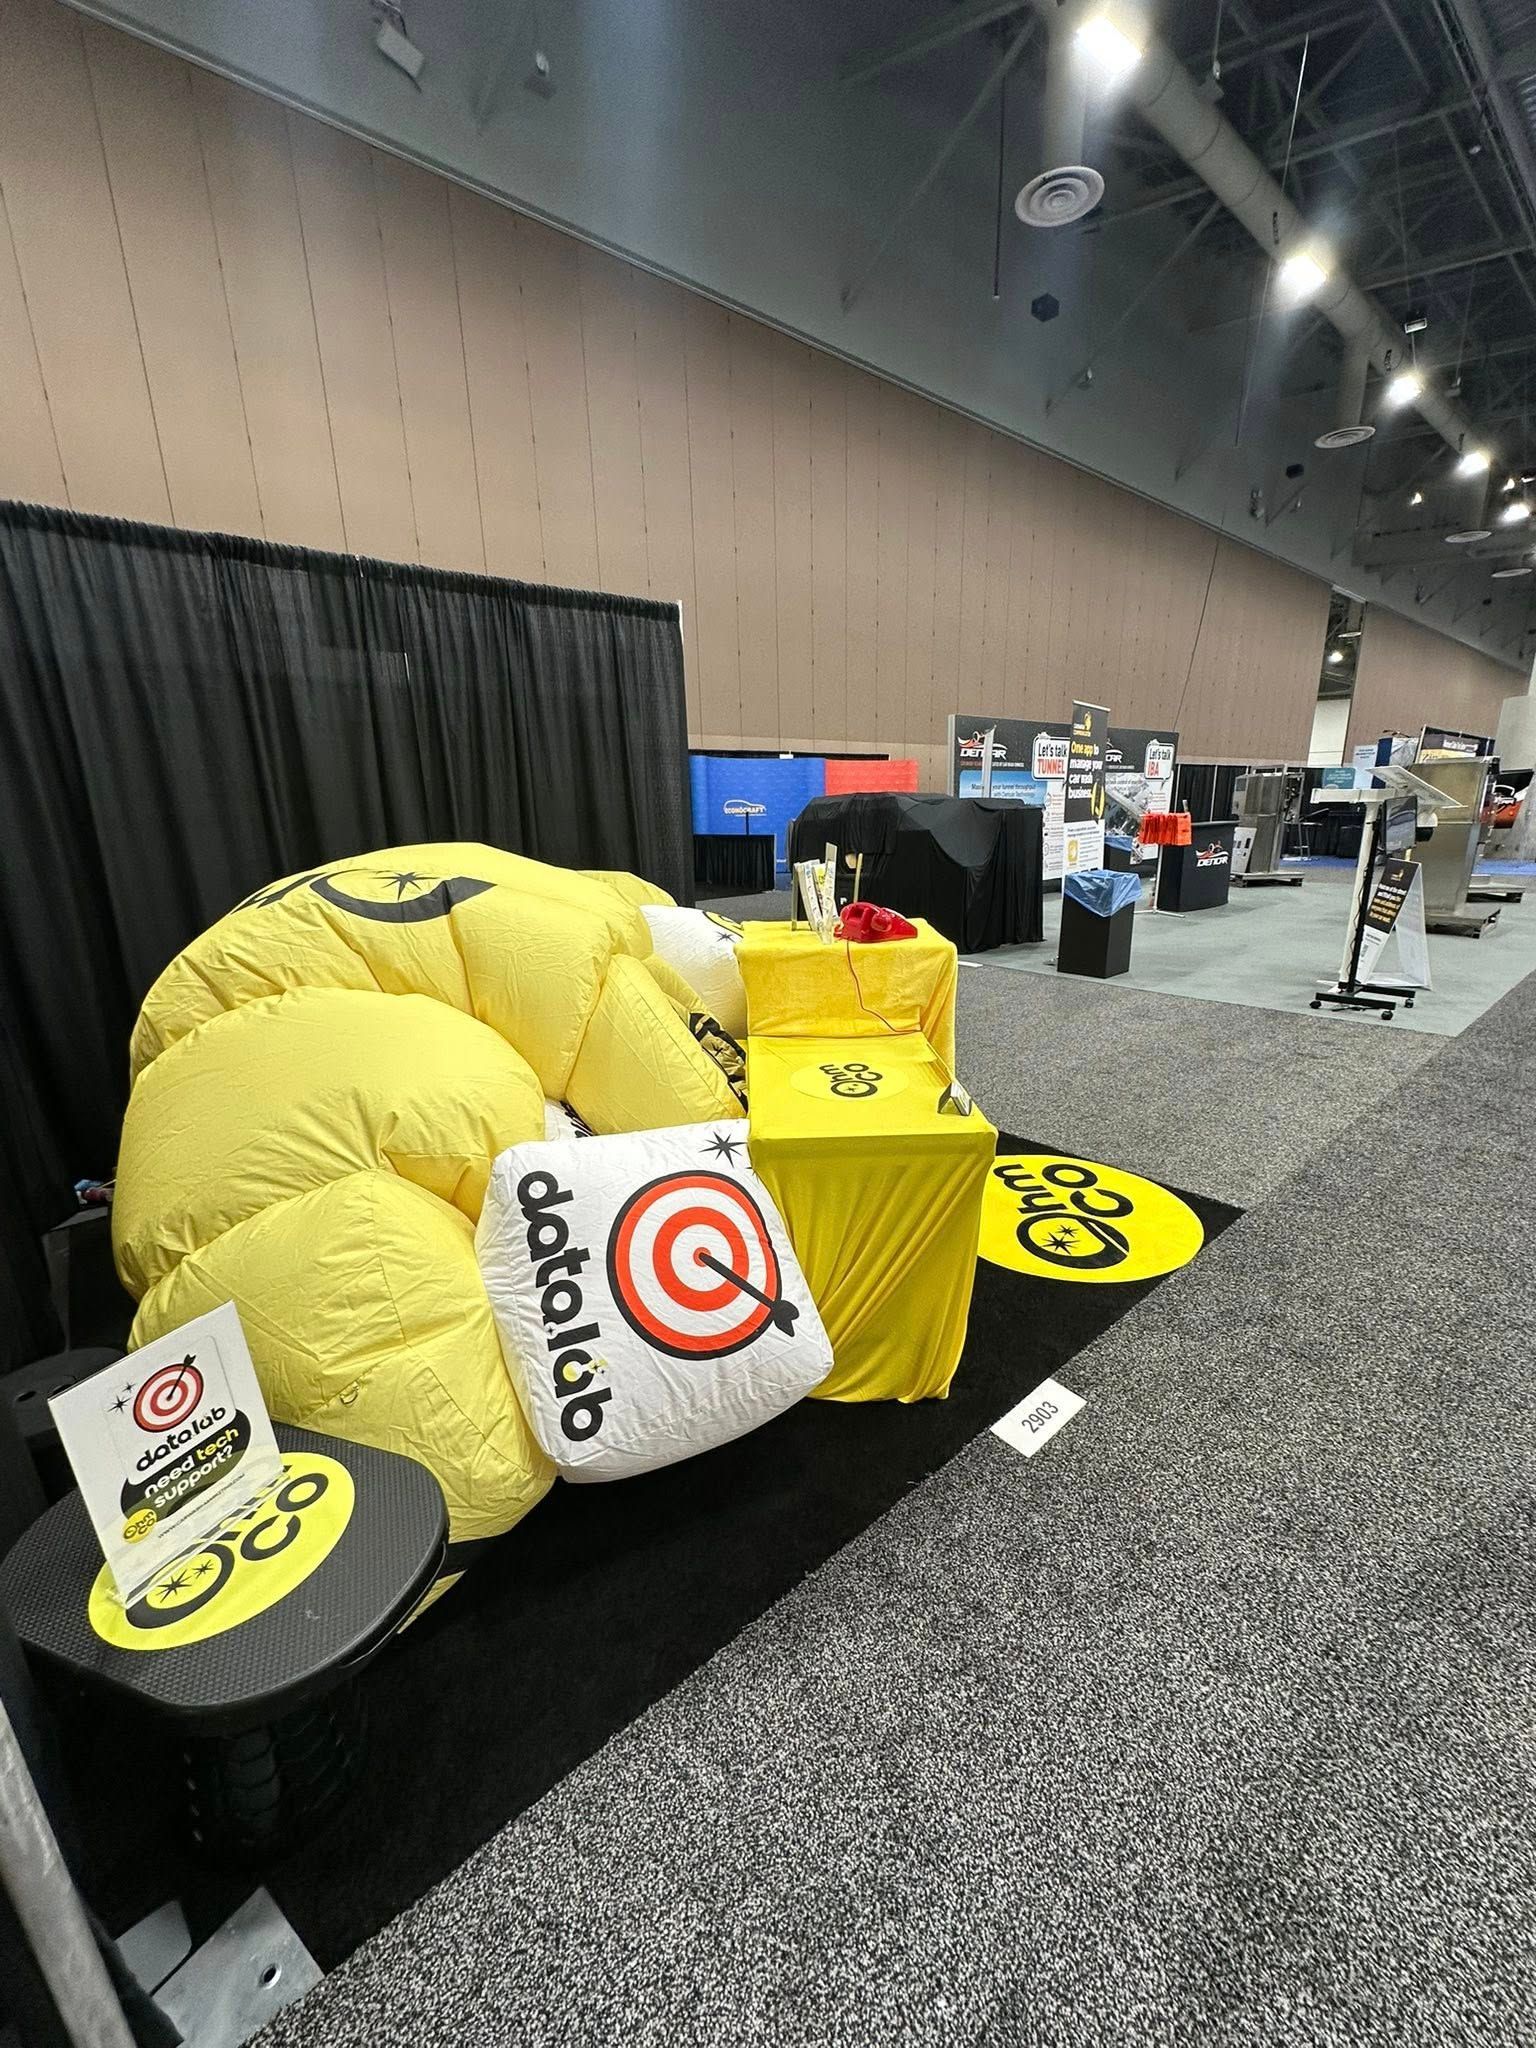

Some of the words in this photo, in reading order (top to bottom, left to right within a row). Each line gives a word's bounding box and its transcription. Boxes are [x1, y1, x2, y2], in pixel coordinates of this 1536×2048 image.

[1038, 742, 1053, 757] Let's
[1055, 744, 1067, 758] talk
[1071, 740, 1083, 754] One
[1082, 744, 1093, 757] app
[1149, 748, 1160, 760] Let's
[1162, 750, 1171, 761] talk
[1038, 759, 1065, 774] TUNNEL
[1147, 761, 1160, 776] IBA
[1069, 774, 1080, 784] car
[819, 1064, 878, 1098] Ohm
[993, 1163, 1130, 1270] Ohm
[1021, 1401, 1059, 1434] 2903
[144, 1456, 195, 1499] need
[195, 1428, 239, 1461] tech
[154, 1445, 234, 1508] support?
